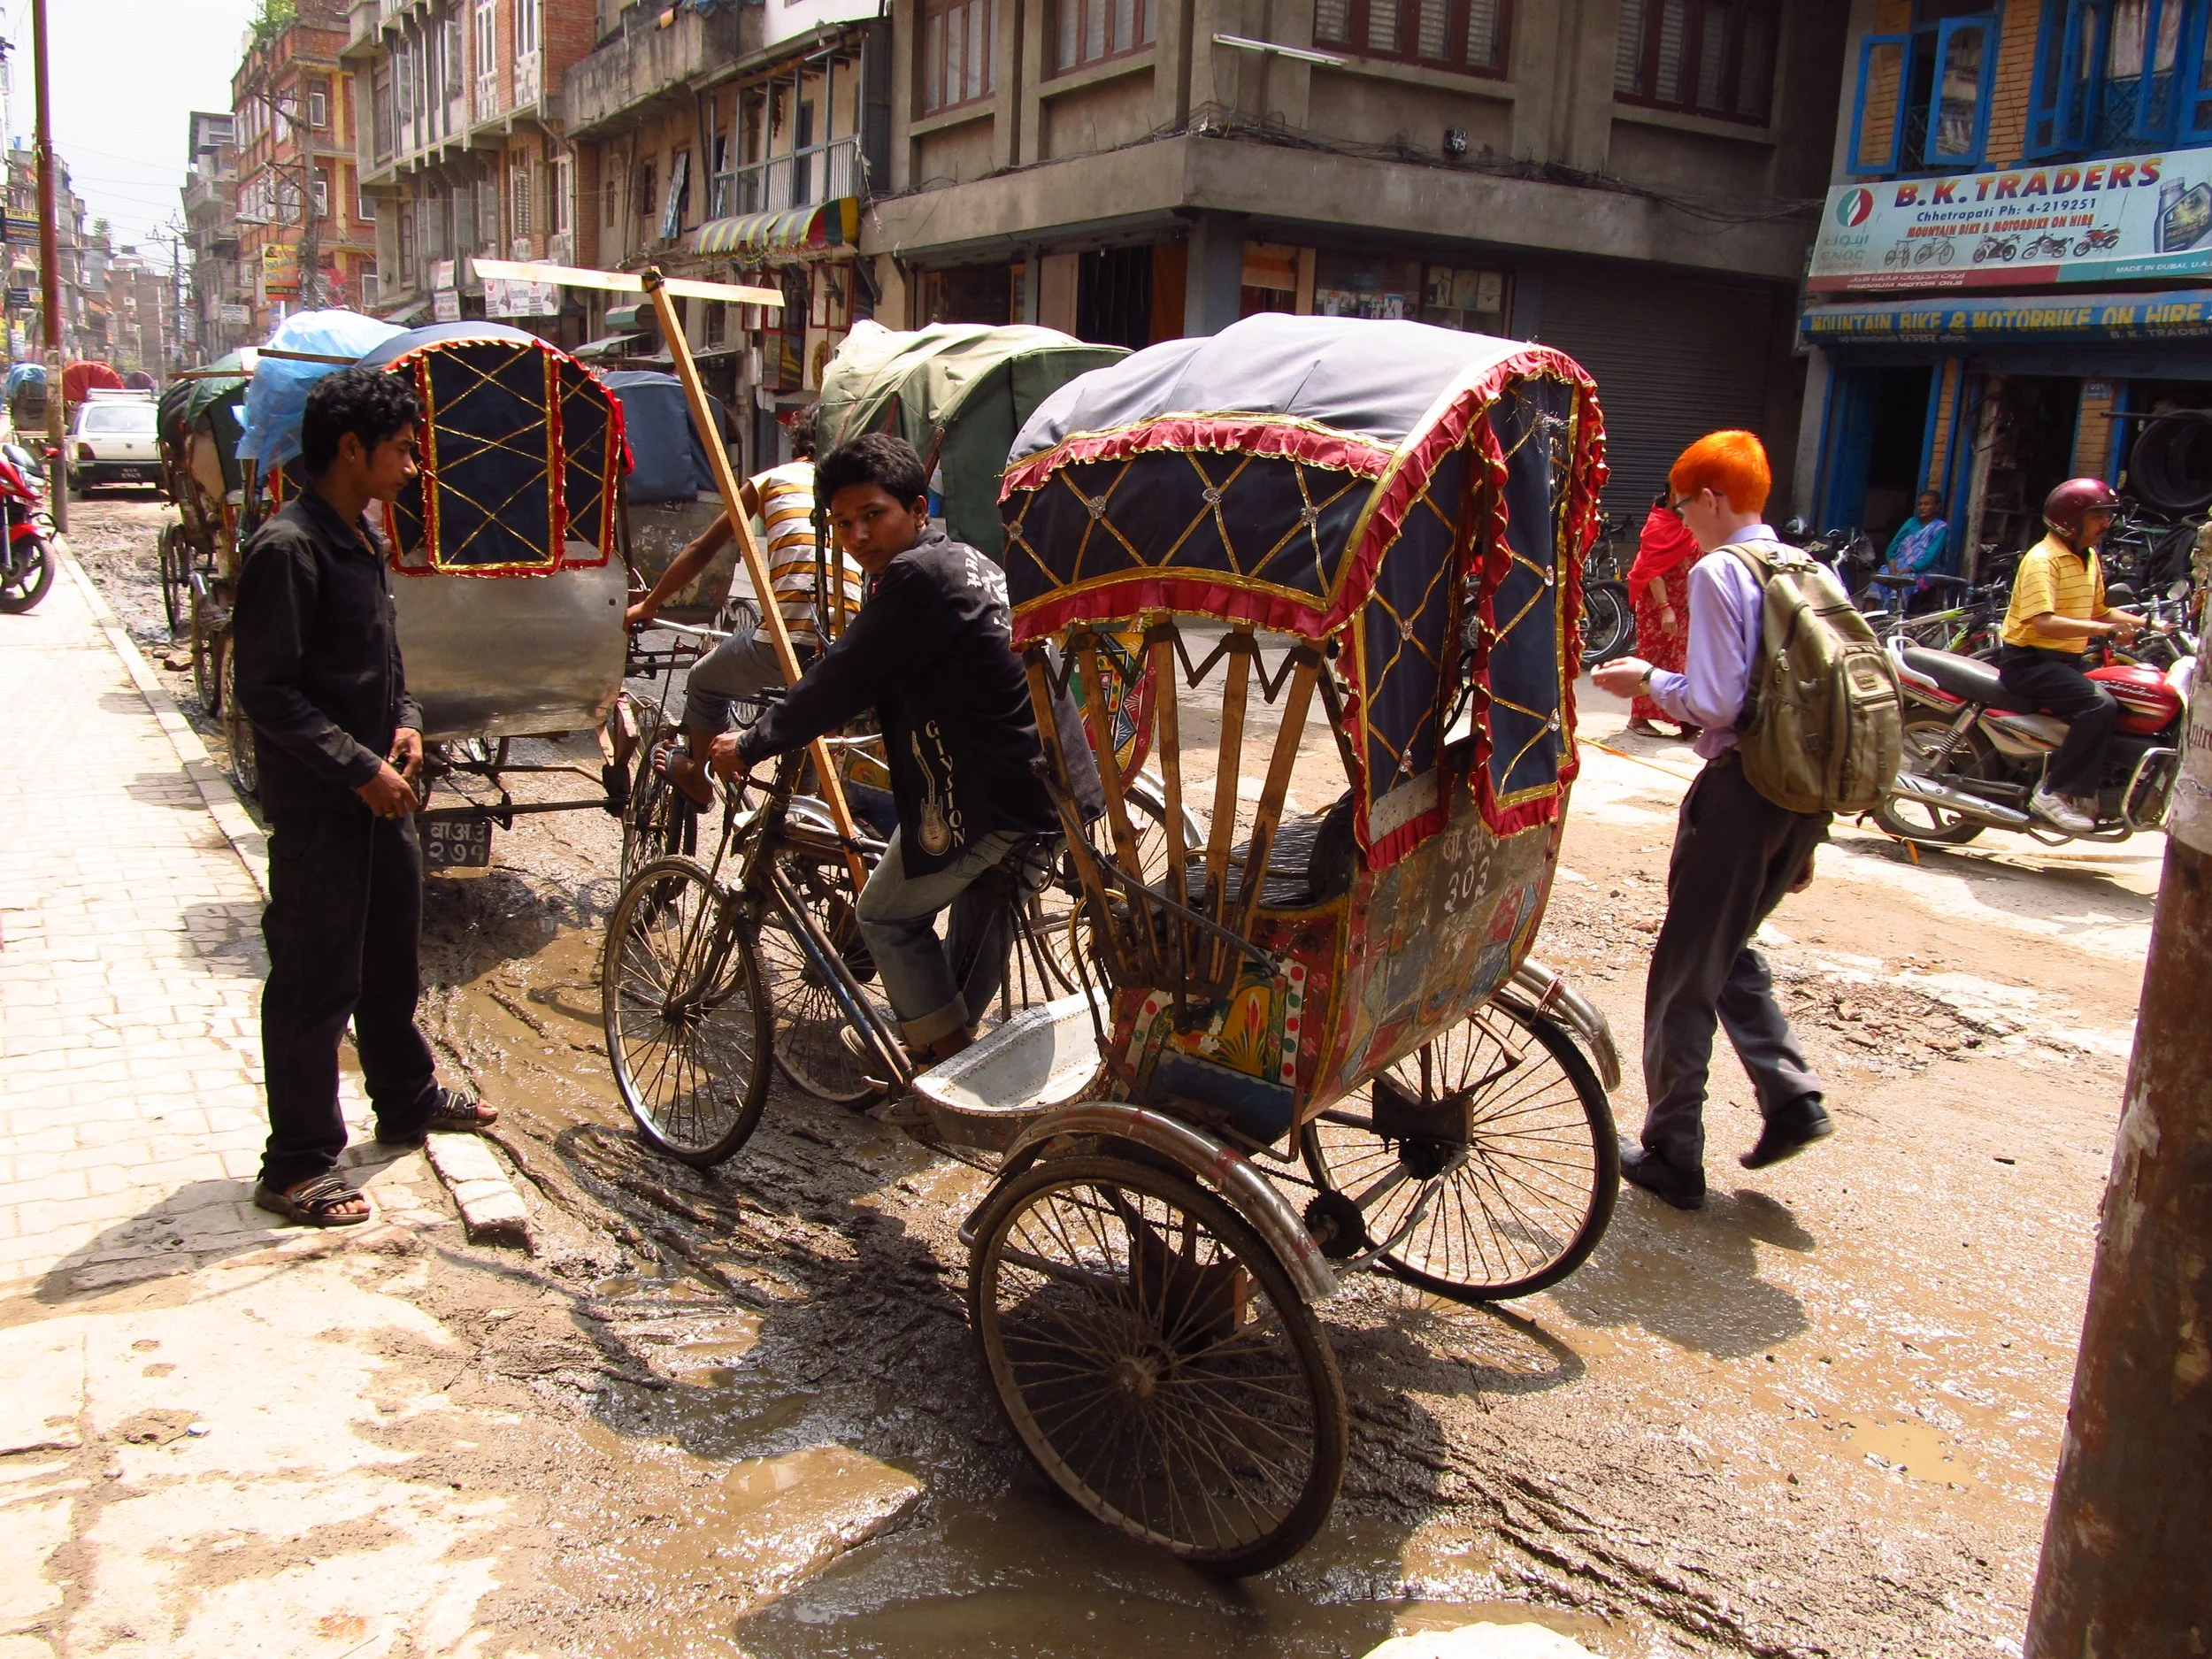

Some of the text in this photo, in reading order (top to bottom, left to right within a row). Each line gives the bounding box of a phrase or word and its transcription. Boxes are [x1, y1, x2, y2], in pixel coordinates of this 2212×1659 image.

[1976, 157, 2162, 202] TRADERS
[1916, 198, 2096, 222] Chhetrapati Ph: 4-219251
[1907, 225, 1956, 238] MOUNTAIN
[1959, 222, 1981, 235] BIKE
[1992, 216, 2049, 233] MOTORBIKE
[2051, 215, 2066, 228] ON
[2069, 213, 2094, 227] HIRE
[2116, 265, 2142, 273] MADE
[1811, 313, 1892, 334] MOUNTAIN
[1899, 311, 1942, 334] BIKE
[1972, 307, 2092, 333] MOTORBIKE
[2101, 305, 2135, 328] ON
[2144, 303, 2202, 327] HIRE
[2147, 327, 2212, 339] TRADER
